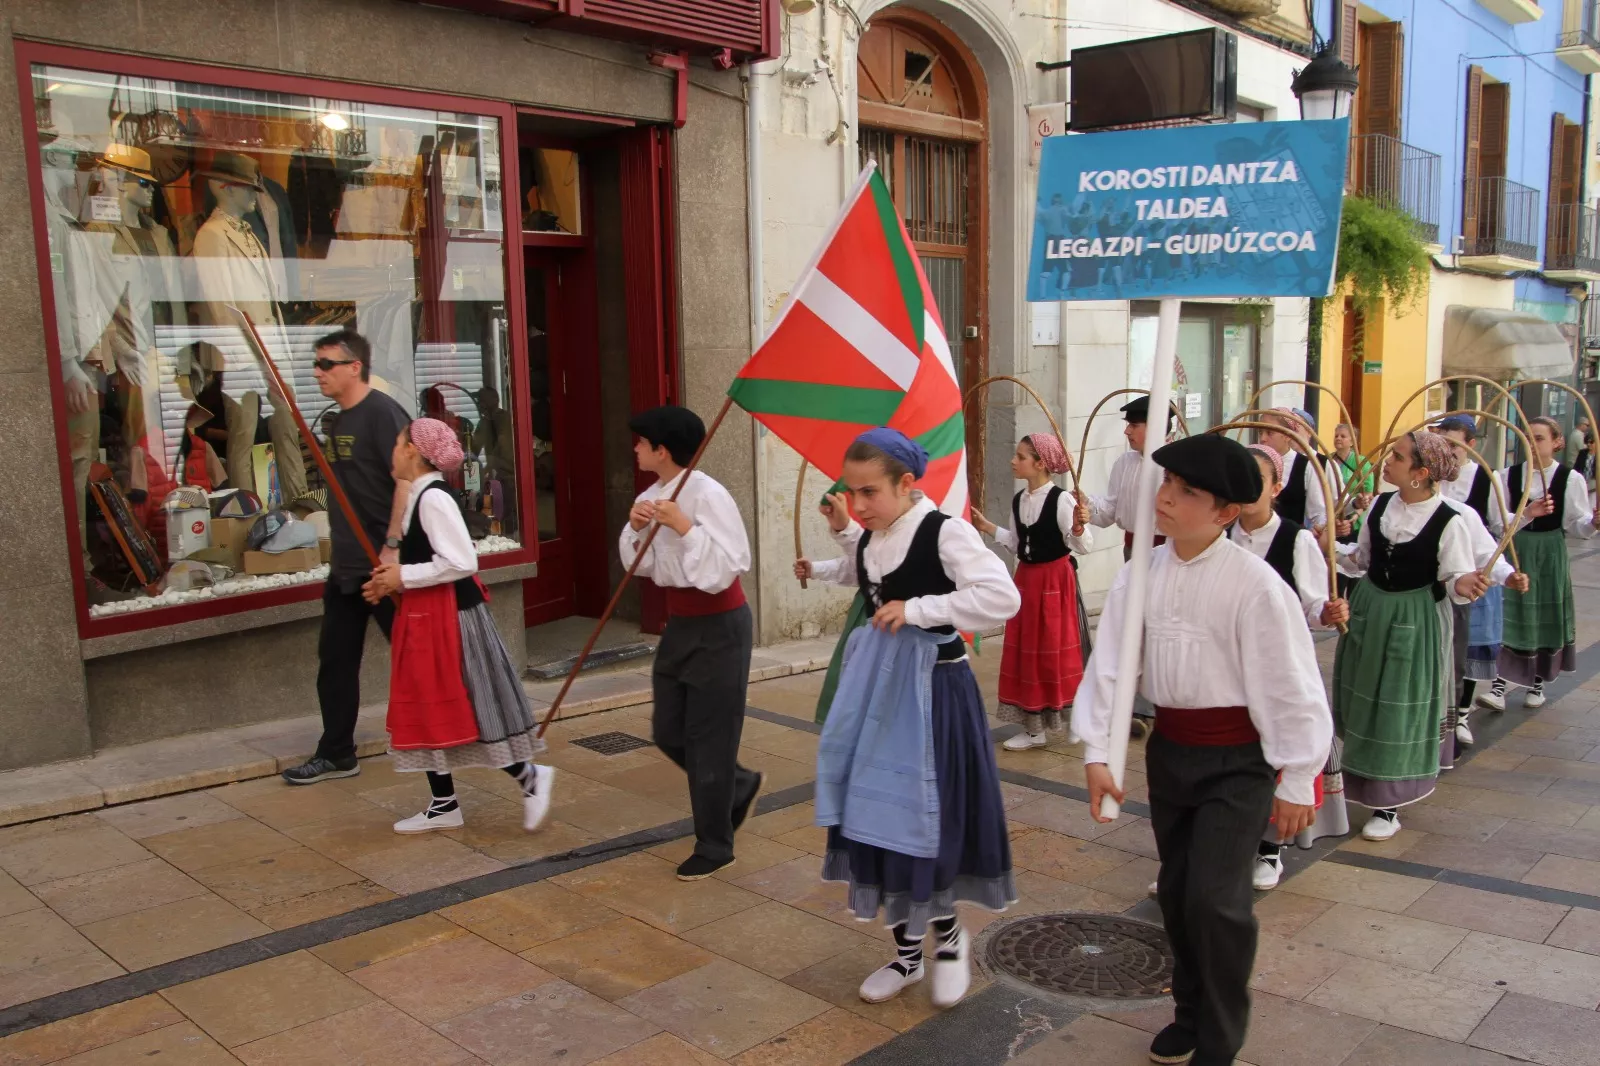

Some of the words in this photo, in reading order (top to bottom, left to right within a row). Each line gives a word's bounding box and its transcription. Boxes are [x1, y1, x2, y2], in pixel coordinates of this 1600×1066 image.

[1079, 166, 1188, 192] KOROSTI
[1191, 160, 1298, 186] DANTZA
[1136, 196, 1228, 220] TALDEA
[1046, 236, 1143, 259] LEGAZPI
[1165, 226, 1316, 255] GUIPÚZCOA
